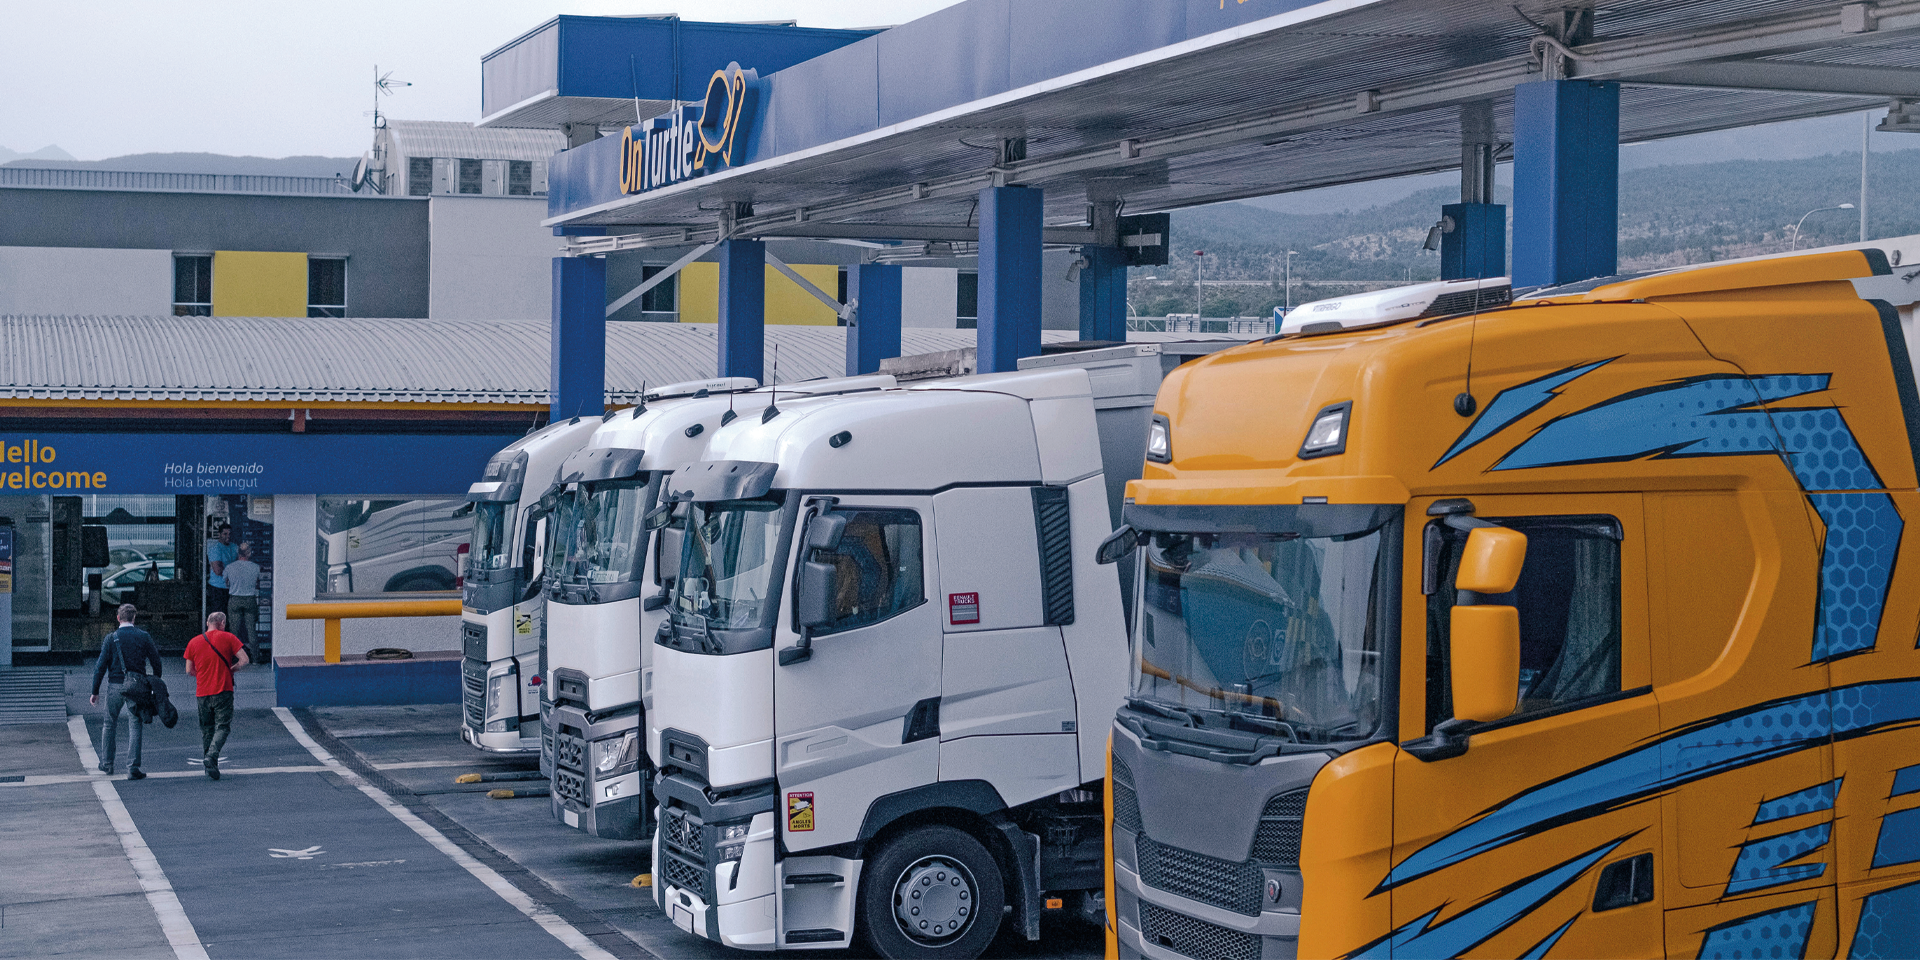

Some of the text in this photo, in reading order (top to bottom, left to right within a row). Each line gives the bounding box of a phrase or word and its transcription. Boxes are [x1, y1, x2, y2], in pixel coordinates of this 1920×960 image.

[620, 106, 694, 195] OnTurtle
[0, 465, 107, 489] elcome
[164, 462, 264, 474] Hola bienvenido
[164, 476, 258, 490] Hola benvingut
